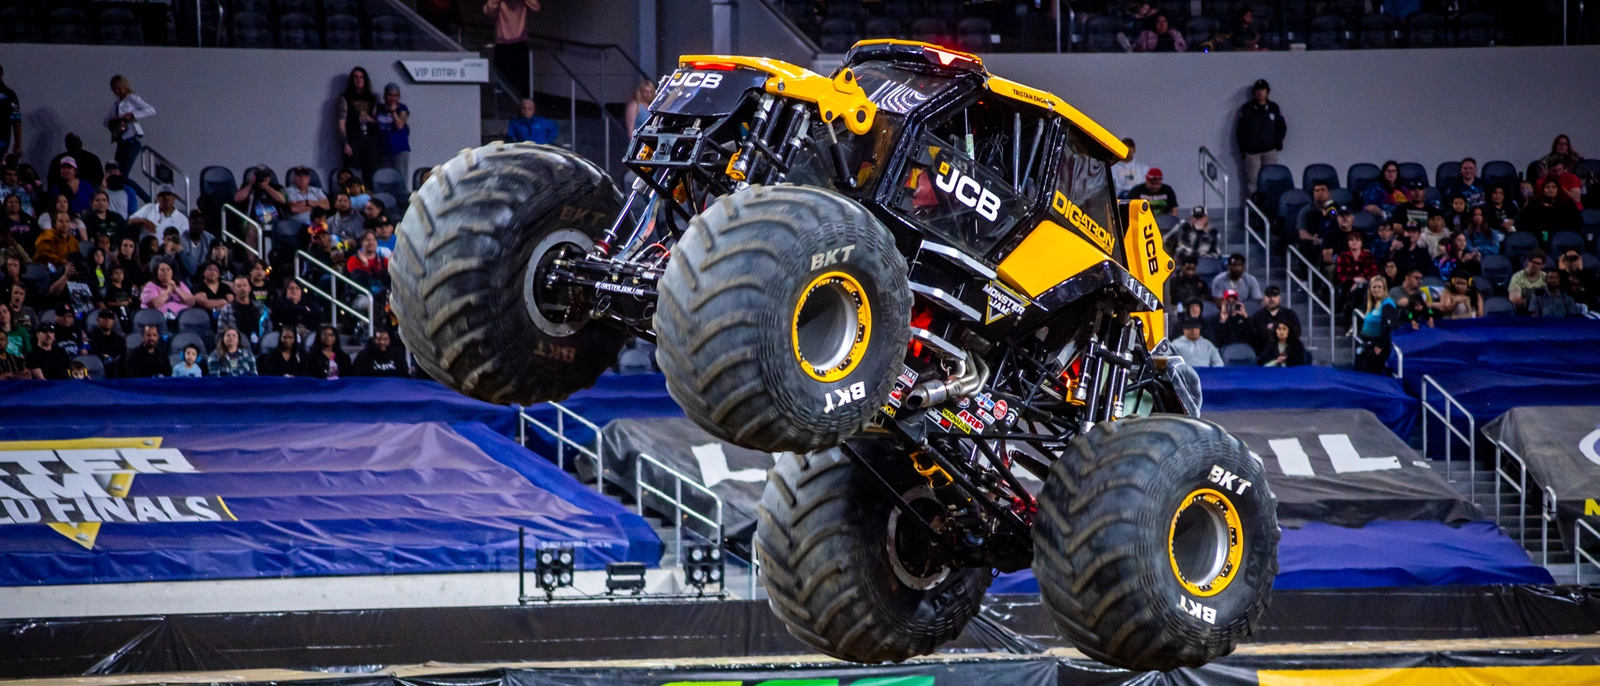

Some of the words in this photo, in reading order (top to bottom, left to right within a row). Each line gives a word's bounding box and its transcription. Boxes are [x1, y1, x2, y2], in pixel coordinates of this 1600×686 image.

[414, 67, 429, 77] VIP
[431, 67, 458, 77] ENTRY
[670, 72, 723, 89] JCB
[1012, 89, 1034, 101] TRISTAN
[935, 166, 1001, 222] JCB
[1052, 190, 1115, 252] DIGATRON
[810, 244, 856, 272] BKT
[1143, 223, 1159, 276] JCB
[982, 283, 1026, 315] MONSTER
[989, 300, 1011, 315] JAM
[823, 381, 866, 414] BKT
[943, 409, 971, 433] MAGNAFLOW
[959, 410, 984, 430] ARP
[1206, 464, 1252, 496] BKT
[44, 496, 222, 523] FINALS
[1175, 593, 1217, 625] BKT
